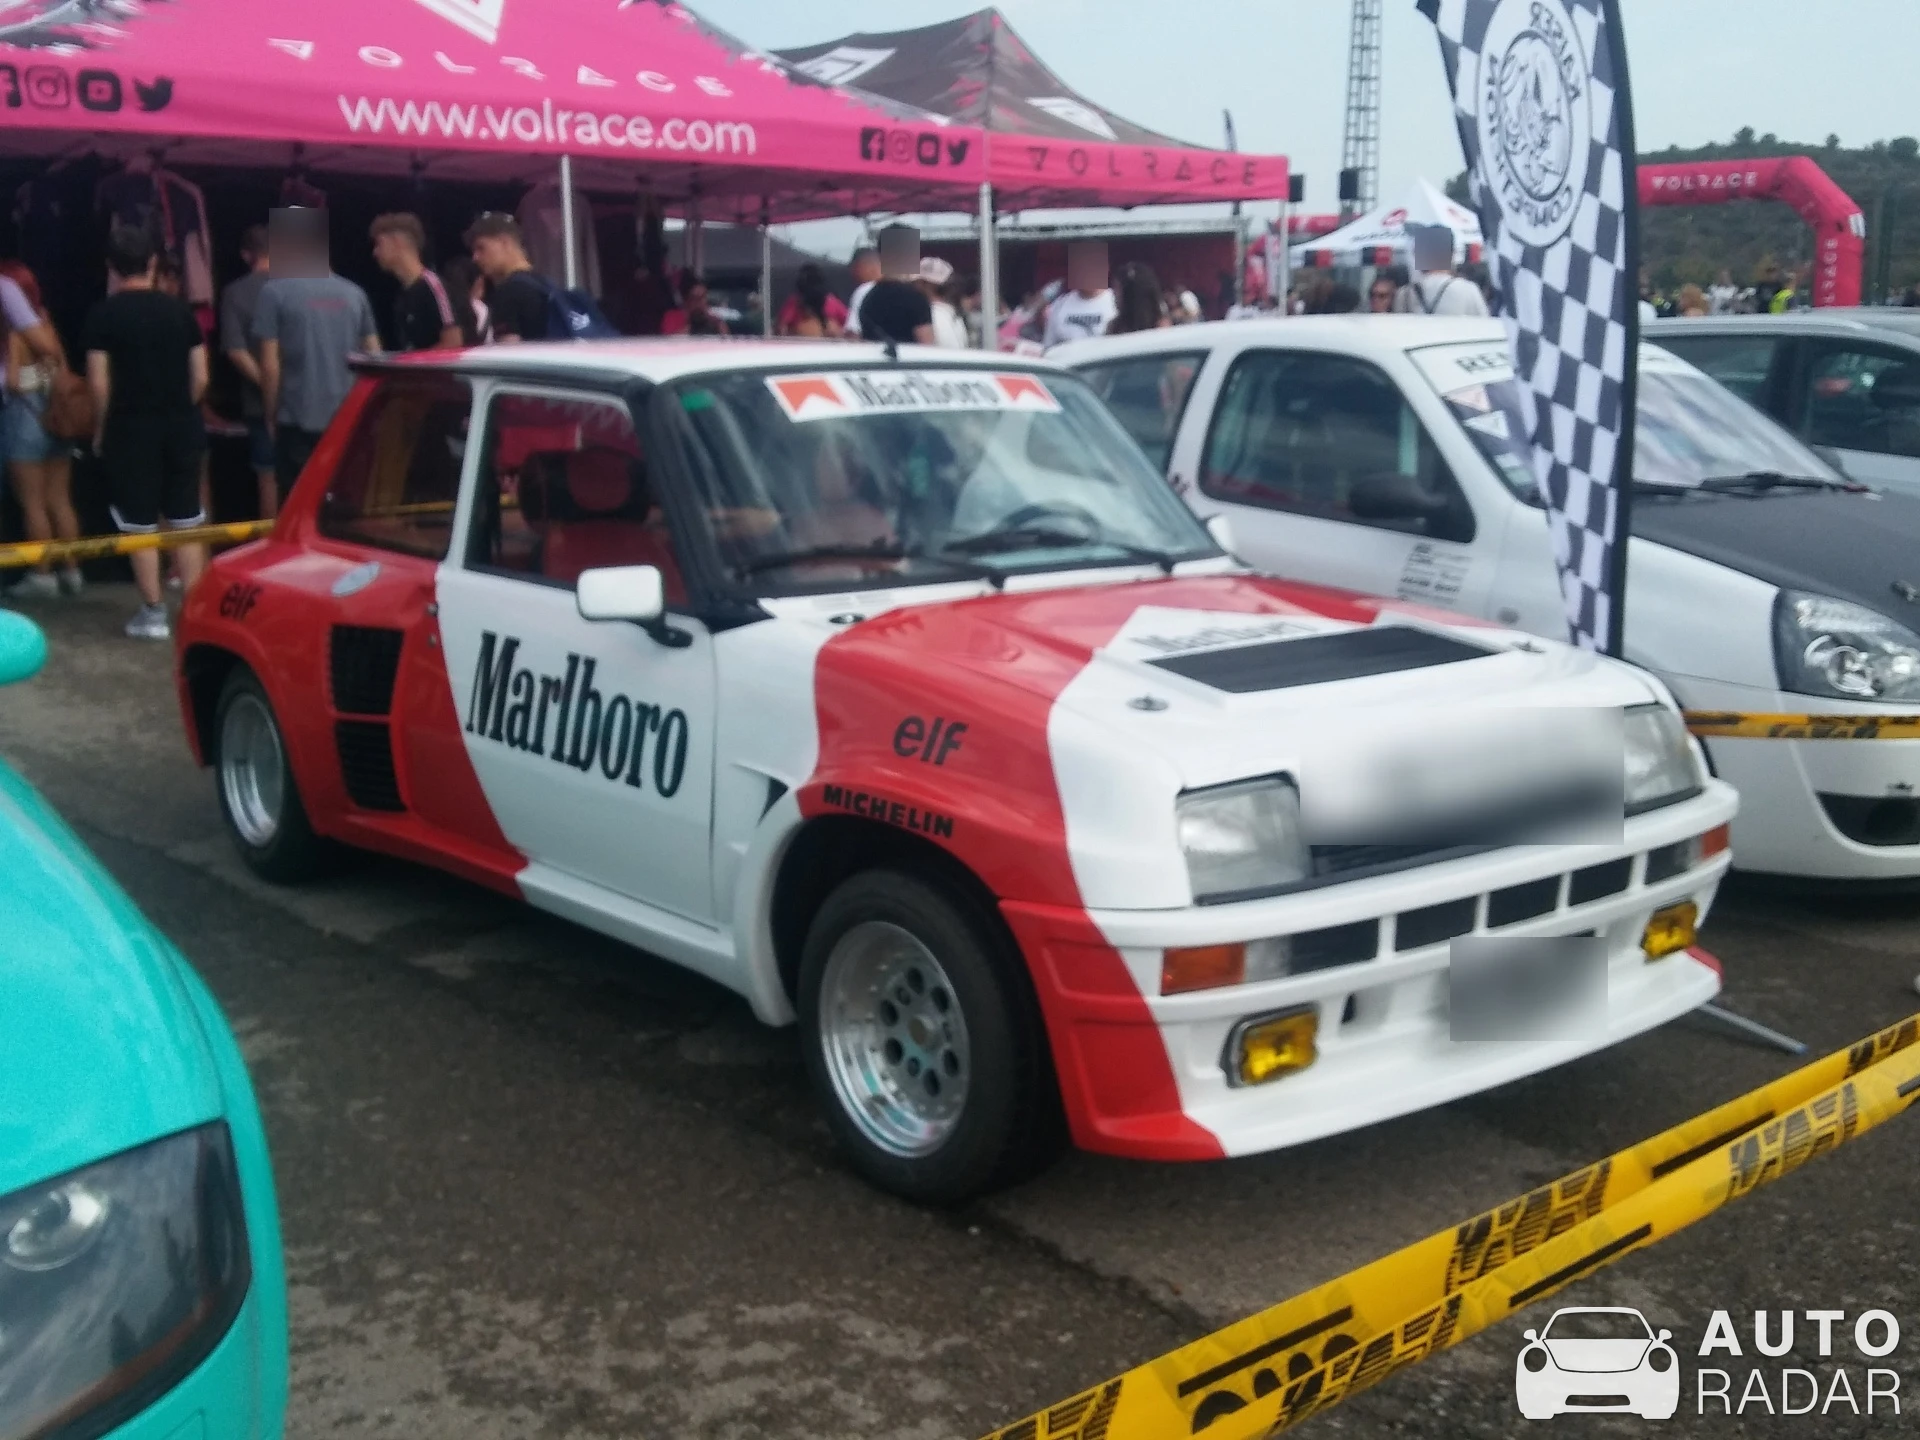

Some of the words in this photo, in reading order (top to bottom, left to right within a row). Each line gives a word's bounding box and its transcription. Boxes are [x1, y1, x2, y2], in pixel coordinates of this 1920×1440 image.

[338, 95, 757, 155] www.volrace.com
[1025, 146, 1258, 187] VOLRACE
[466, 630, 688, 799] Marlboro
[892, 714, 968, 766] elf
[822, 784, 954, 839] MICHELIN
